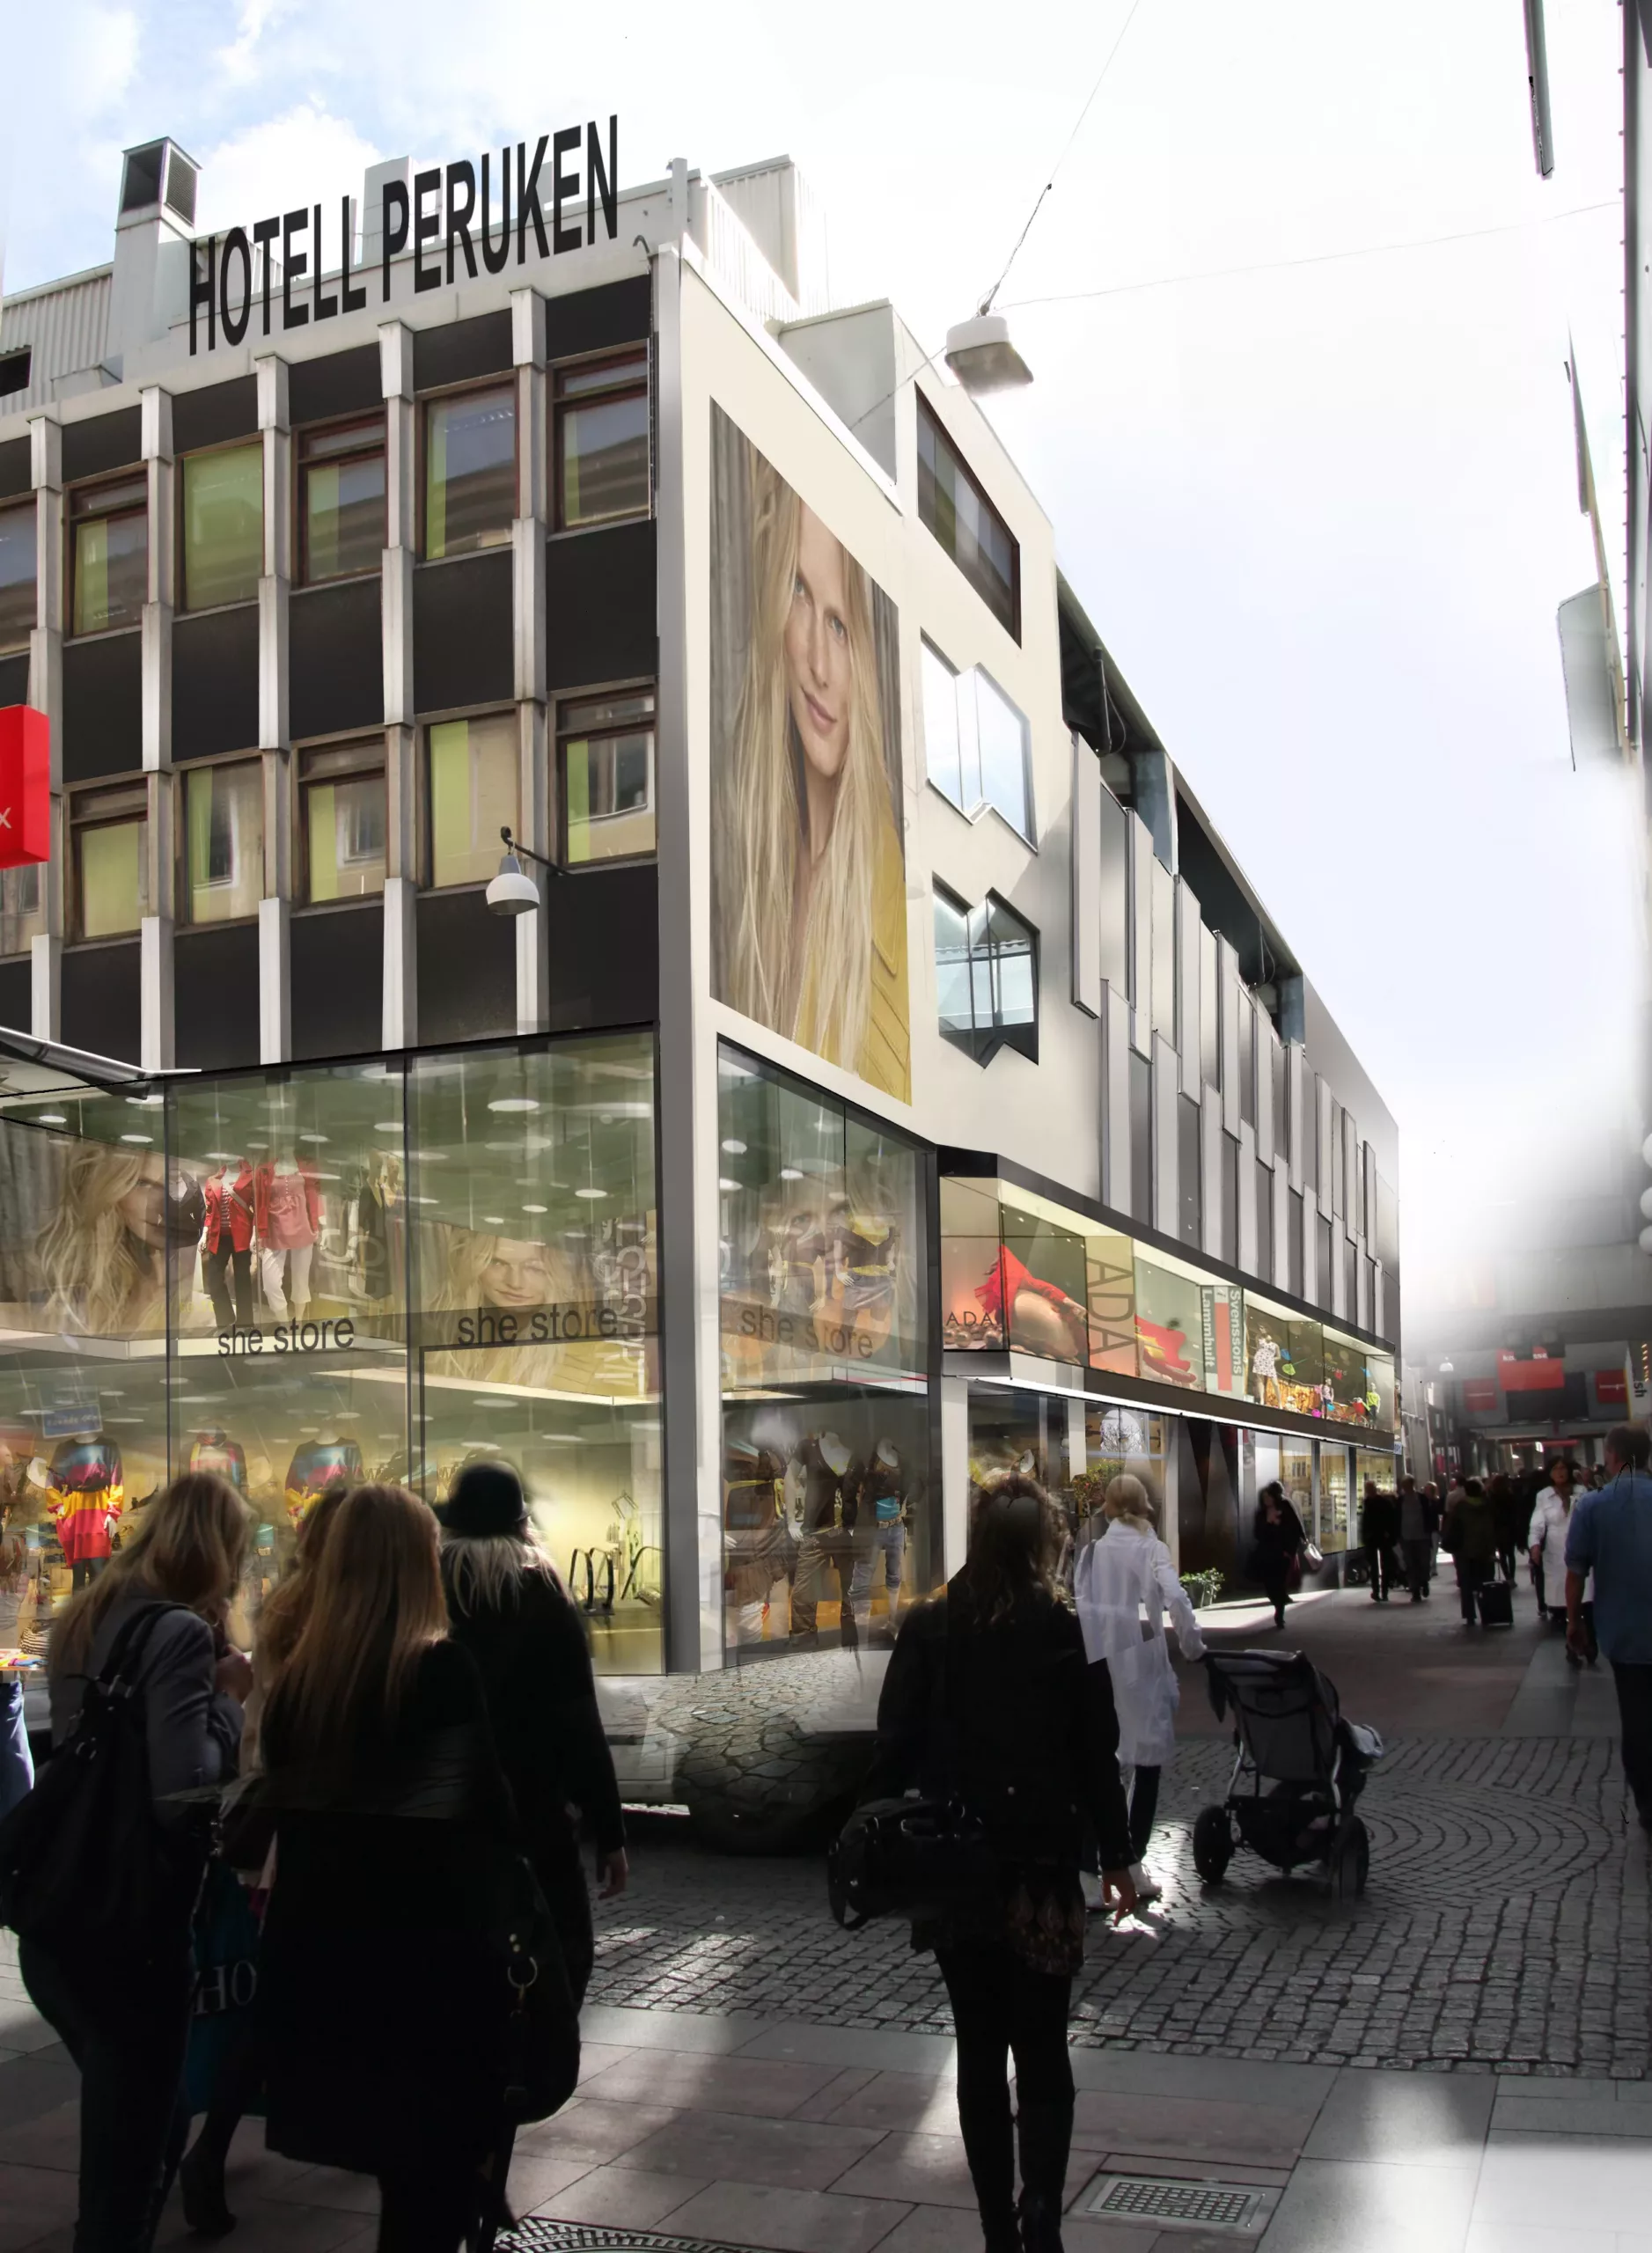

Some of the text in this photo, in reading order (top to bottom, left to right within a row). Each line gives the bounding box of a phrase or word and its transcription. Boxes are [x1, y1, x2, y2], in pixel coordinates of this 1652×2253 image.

[187, 114, 619, 356] HOTELL PERUKEN
[457, 1304, 618, 1347] she store
[741, 1305, 793, 1343] she
[946, 1310, 993, 1327] ADA
[1087, 1257, 1136, 1354] ADA
[1201, 1288, 1215, 1368] Lammhult
[1230, 1289, 1243, 1375] Svenssons
[217, 1317, 355, 1356] she store
